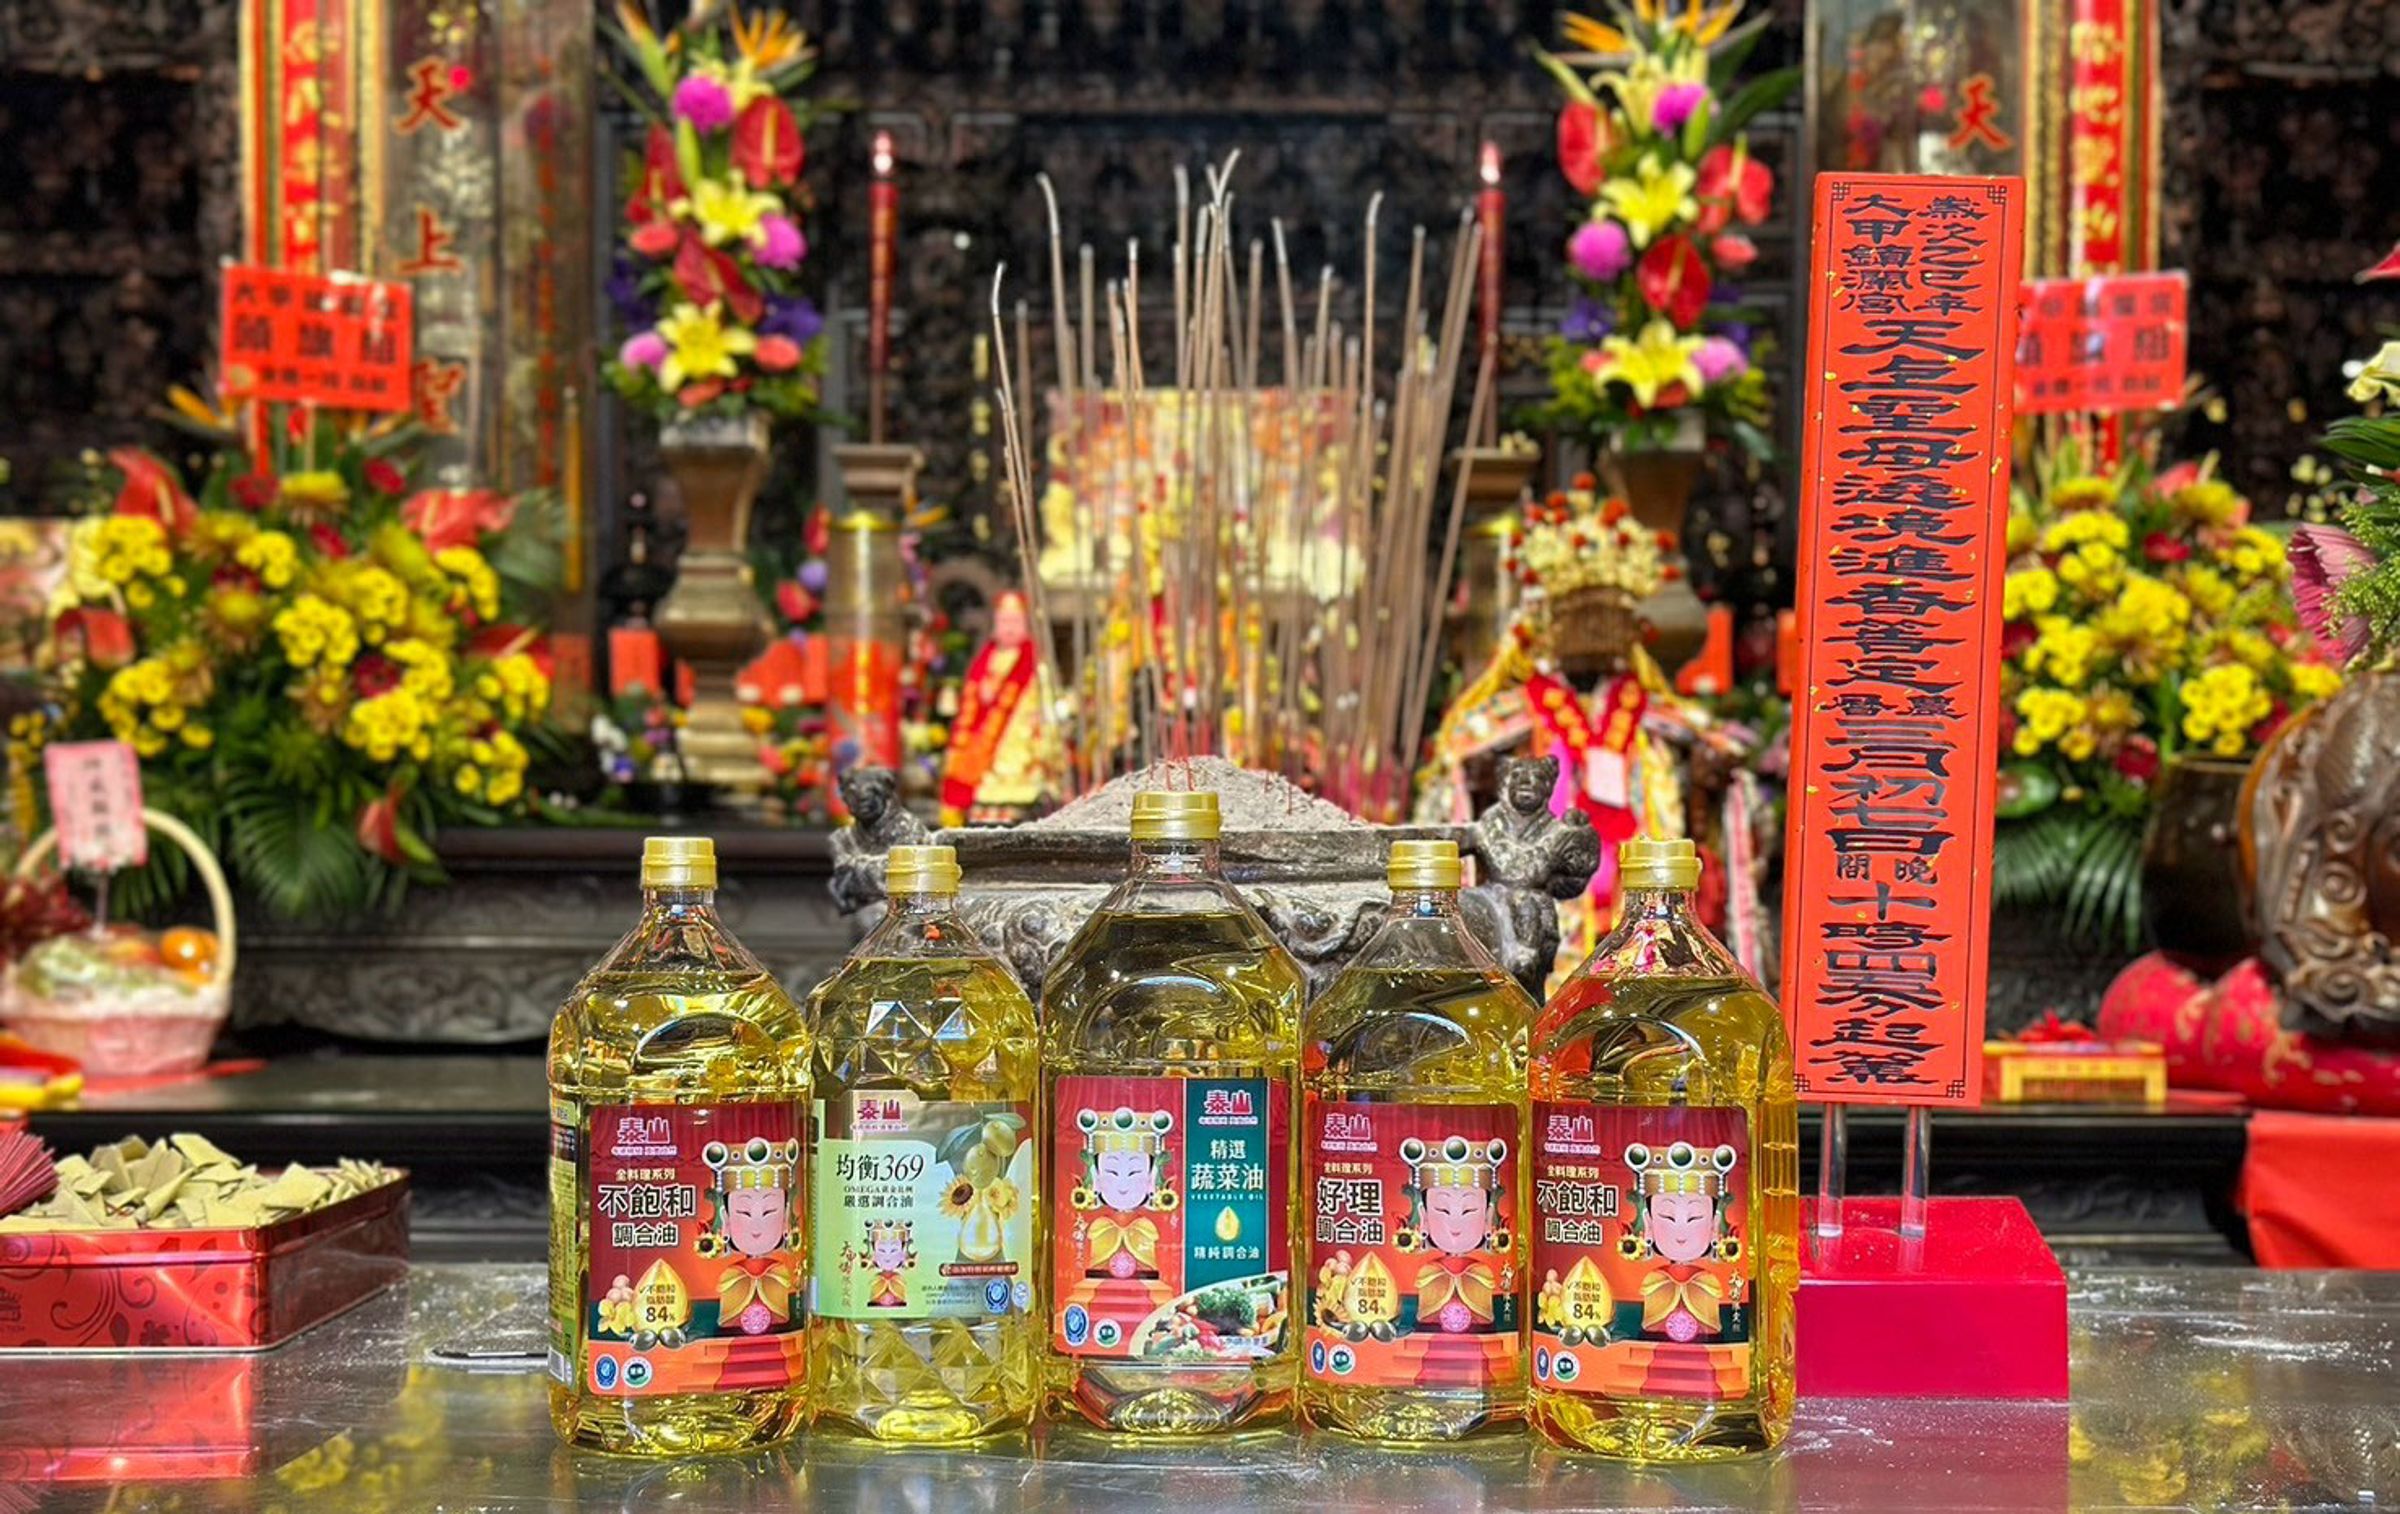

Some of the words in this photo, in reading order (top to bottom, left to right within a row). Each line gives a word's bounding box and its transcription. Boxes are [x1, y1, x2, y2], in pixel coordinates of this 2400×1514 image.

[1948, 73, 2012, 150] 天
[1839, 193, 1917, 315] 大甲鎮瀾宮
[856, 1099, 901, 1120] 泰山
[1204, 1089, 1252, 1115] 泰山
[616, 1116, 671, 1145] 泰山
[1324, 1112, 1371, 1141] 泰山
[1547, 1115, 1594, 1142] 泰山
[1210, 1139, 1246, 1159] 精選
[836, 1153, 924, 1182] 均衡369
[1191, 1163, 1264, 1191] 蔬菜油
[598, 1183, 696, 1218] 不飽和
[1317, 1176, 1383, 1216] 好理
[1536, 1180, 1619, 1217] 不飽和
[612, 1222, 678, 1247] 調合油
[1316, 1215, 1385, 1245] 調合油
[1544, 1217, 1603, 1245] 調合油
